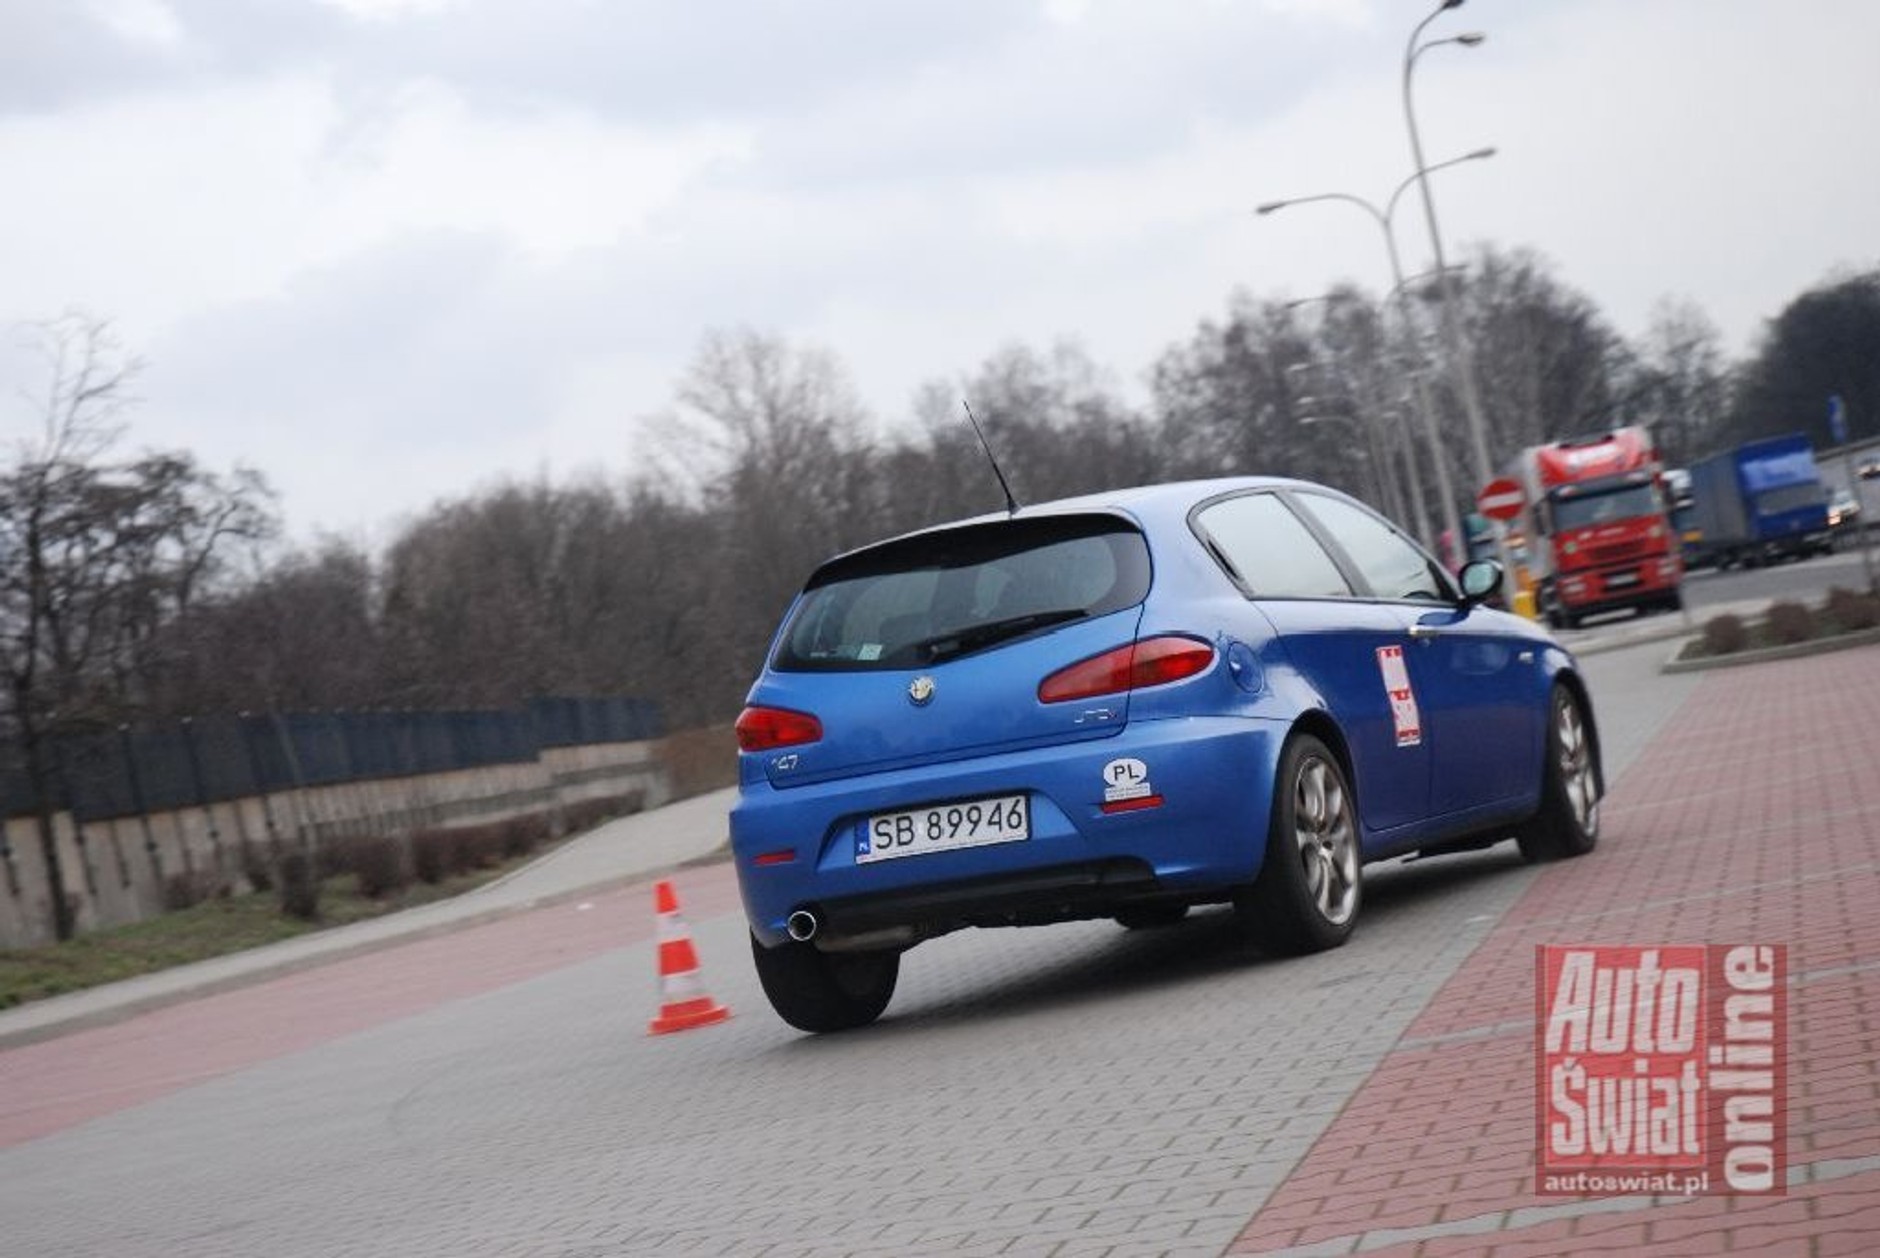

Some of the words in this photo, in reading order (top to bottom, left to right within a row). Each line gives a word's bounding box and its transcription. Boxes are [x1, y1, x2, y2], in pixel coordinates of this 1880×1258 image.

[1113, 764, 1140, 781] PL
[874, 815, 915, 850] SB
[926, 798, 1023, 841] 89946
